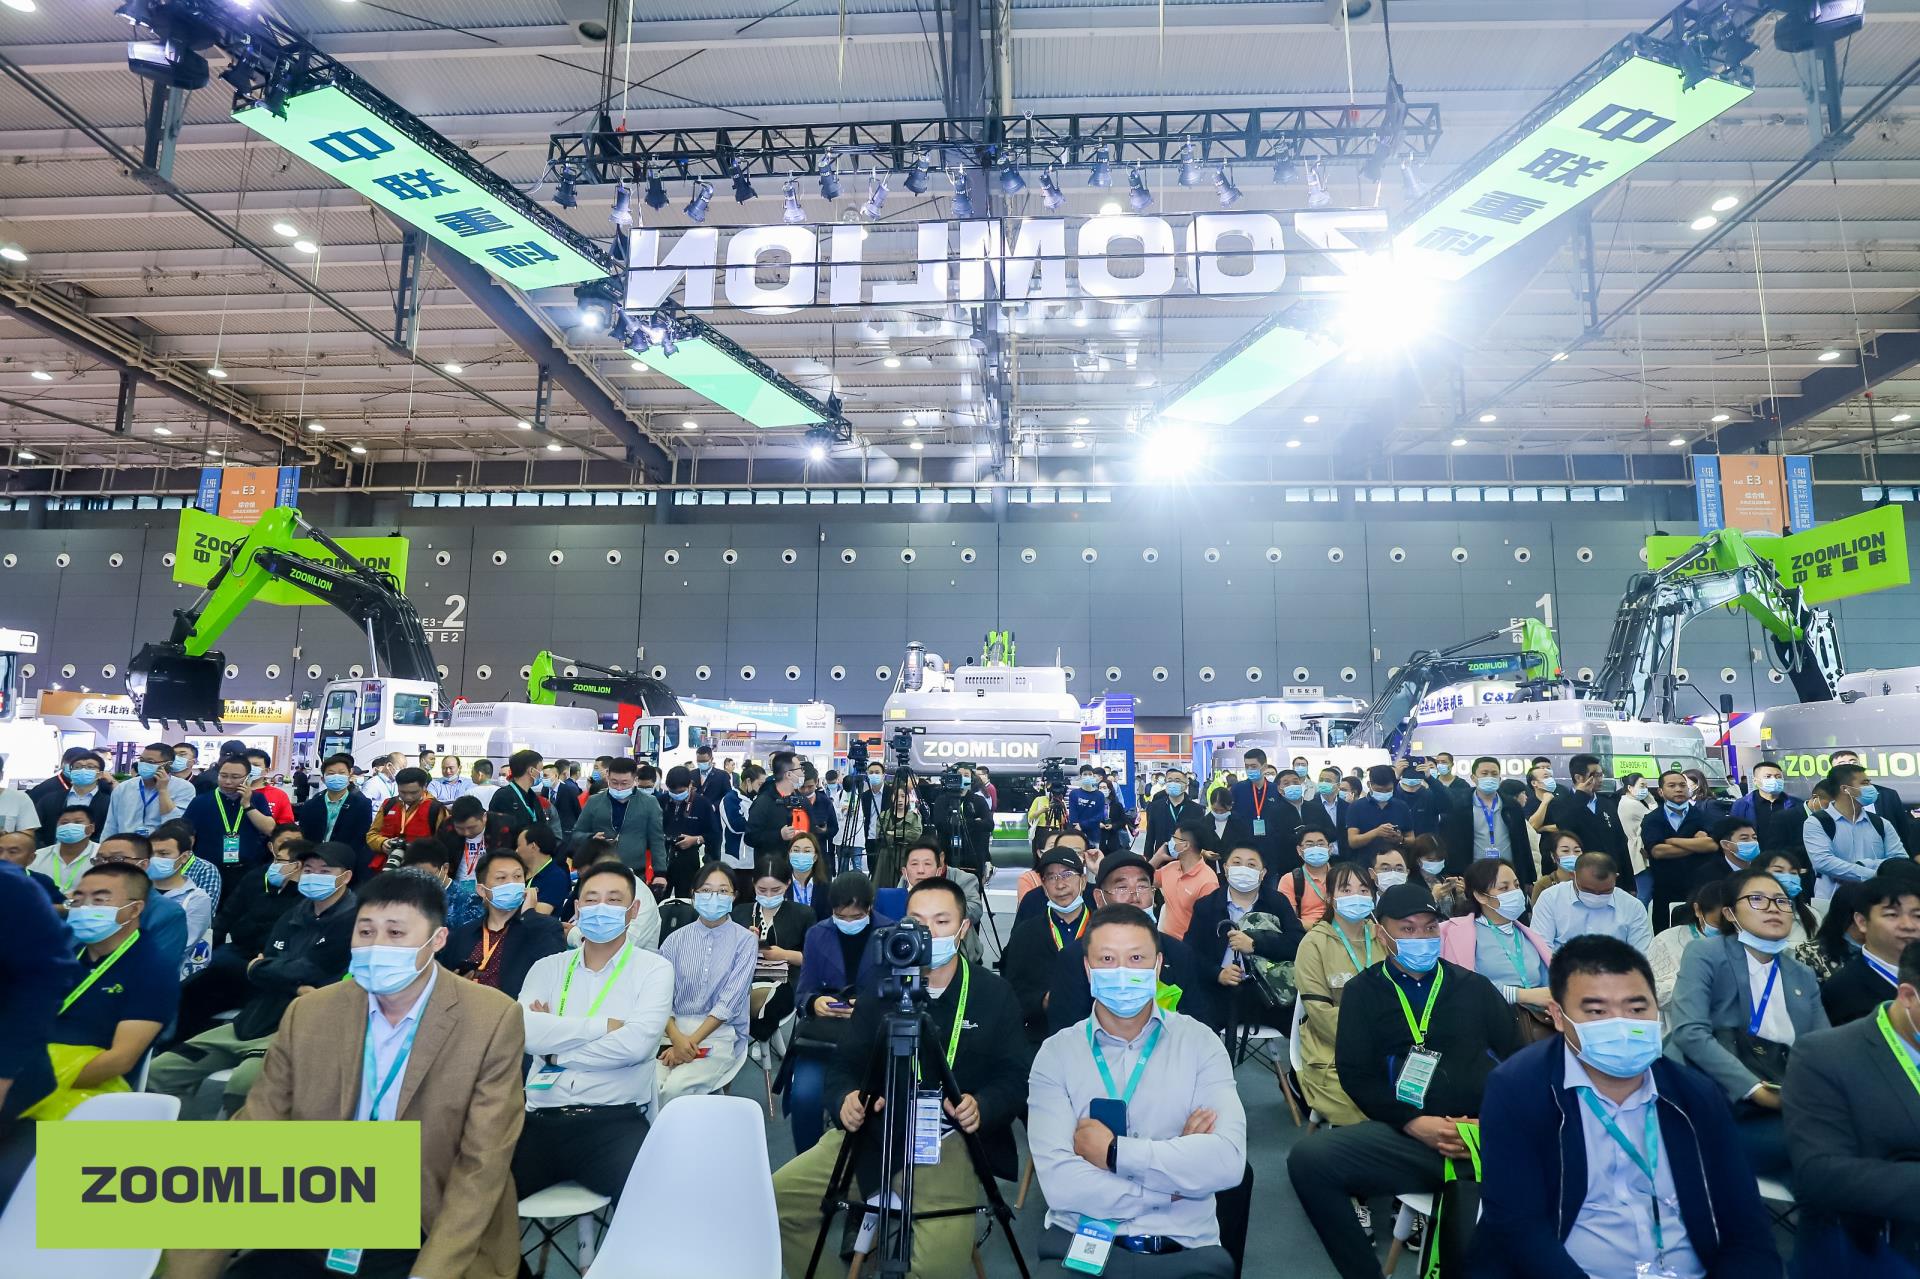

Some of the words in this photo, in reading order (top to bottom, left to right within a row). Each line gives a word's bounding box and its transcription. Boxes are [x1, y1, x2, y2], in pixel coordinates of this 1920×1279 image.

[309, 127, 560, 268] 中联重科
[1746, 475, 1762, 485] E3
[242, 485, 256, 495] E3
[1791, 531, 1885, 570] ZOOMLION
[289, 568, 333, 592] ZOOMLION
[440, 632, 459, 643] E2
[1467, 660, 1508, 671] ZOOMLION
[572, 682, 612, 695] ZOOMLION
[923, 740, 1039, 758] ZOOMLION
[1785, 752, 1920, 777] ZOOLIO
